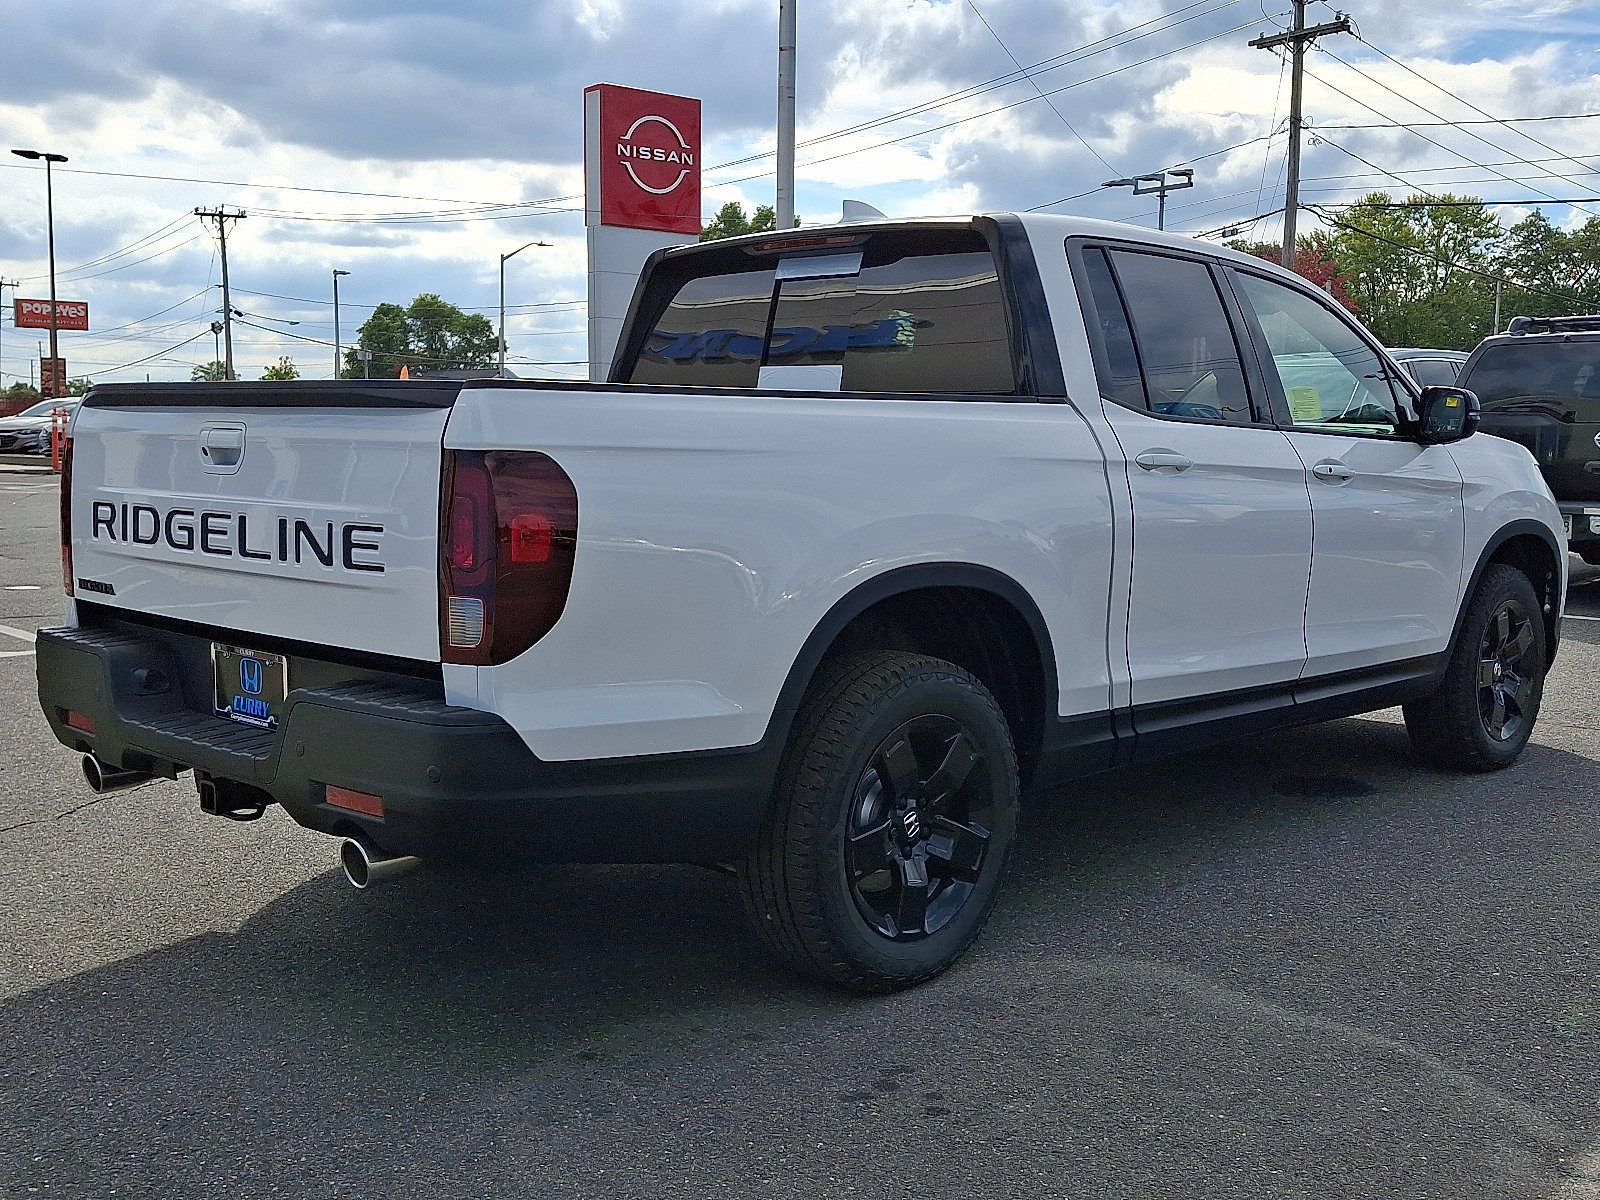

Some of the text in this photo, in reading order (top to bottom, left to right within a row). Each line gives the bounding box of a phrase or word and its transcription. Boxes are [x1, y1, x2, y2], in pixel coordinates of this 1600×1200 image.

[617, 143, 693, 165] NISSAN
[92, 501, 385, 573] RIDGELINE
[233, 695, 270, 718] CURRY
